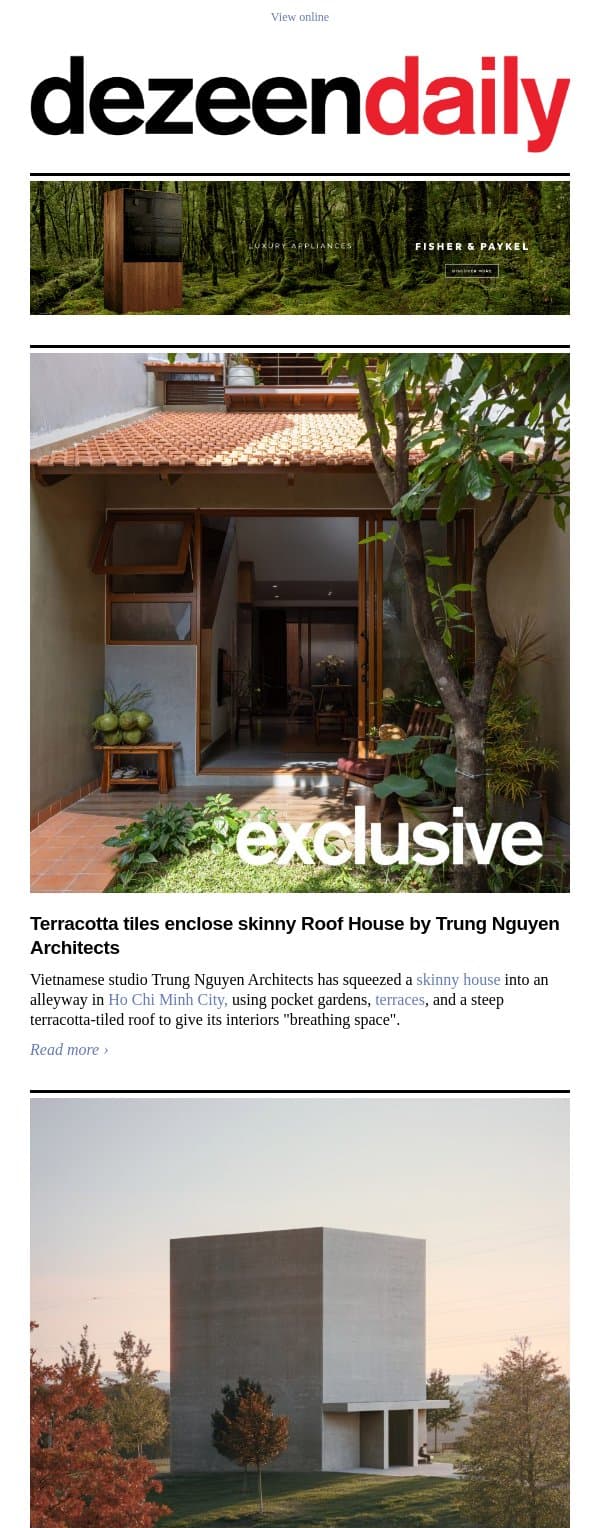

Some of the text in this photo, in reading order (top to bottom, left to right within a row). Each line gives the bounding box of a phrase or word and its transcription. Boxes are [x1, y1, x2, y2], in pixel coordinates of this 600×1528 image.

[271, 11, 330, 22] View online
[415, 242, 529, 251] FISHER & PAYKEL
[29, 916, 560, 935] Terracotta tiles enclose skinny Roof House by Trung Nguyen
[29, 940, 121, 955] Architects
[29, 971, 549, 990] Vietnamese studio Trung Nguyen Architects has squeezed a skinny house into an
[29, 1042, 100, 1056] Read more
